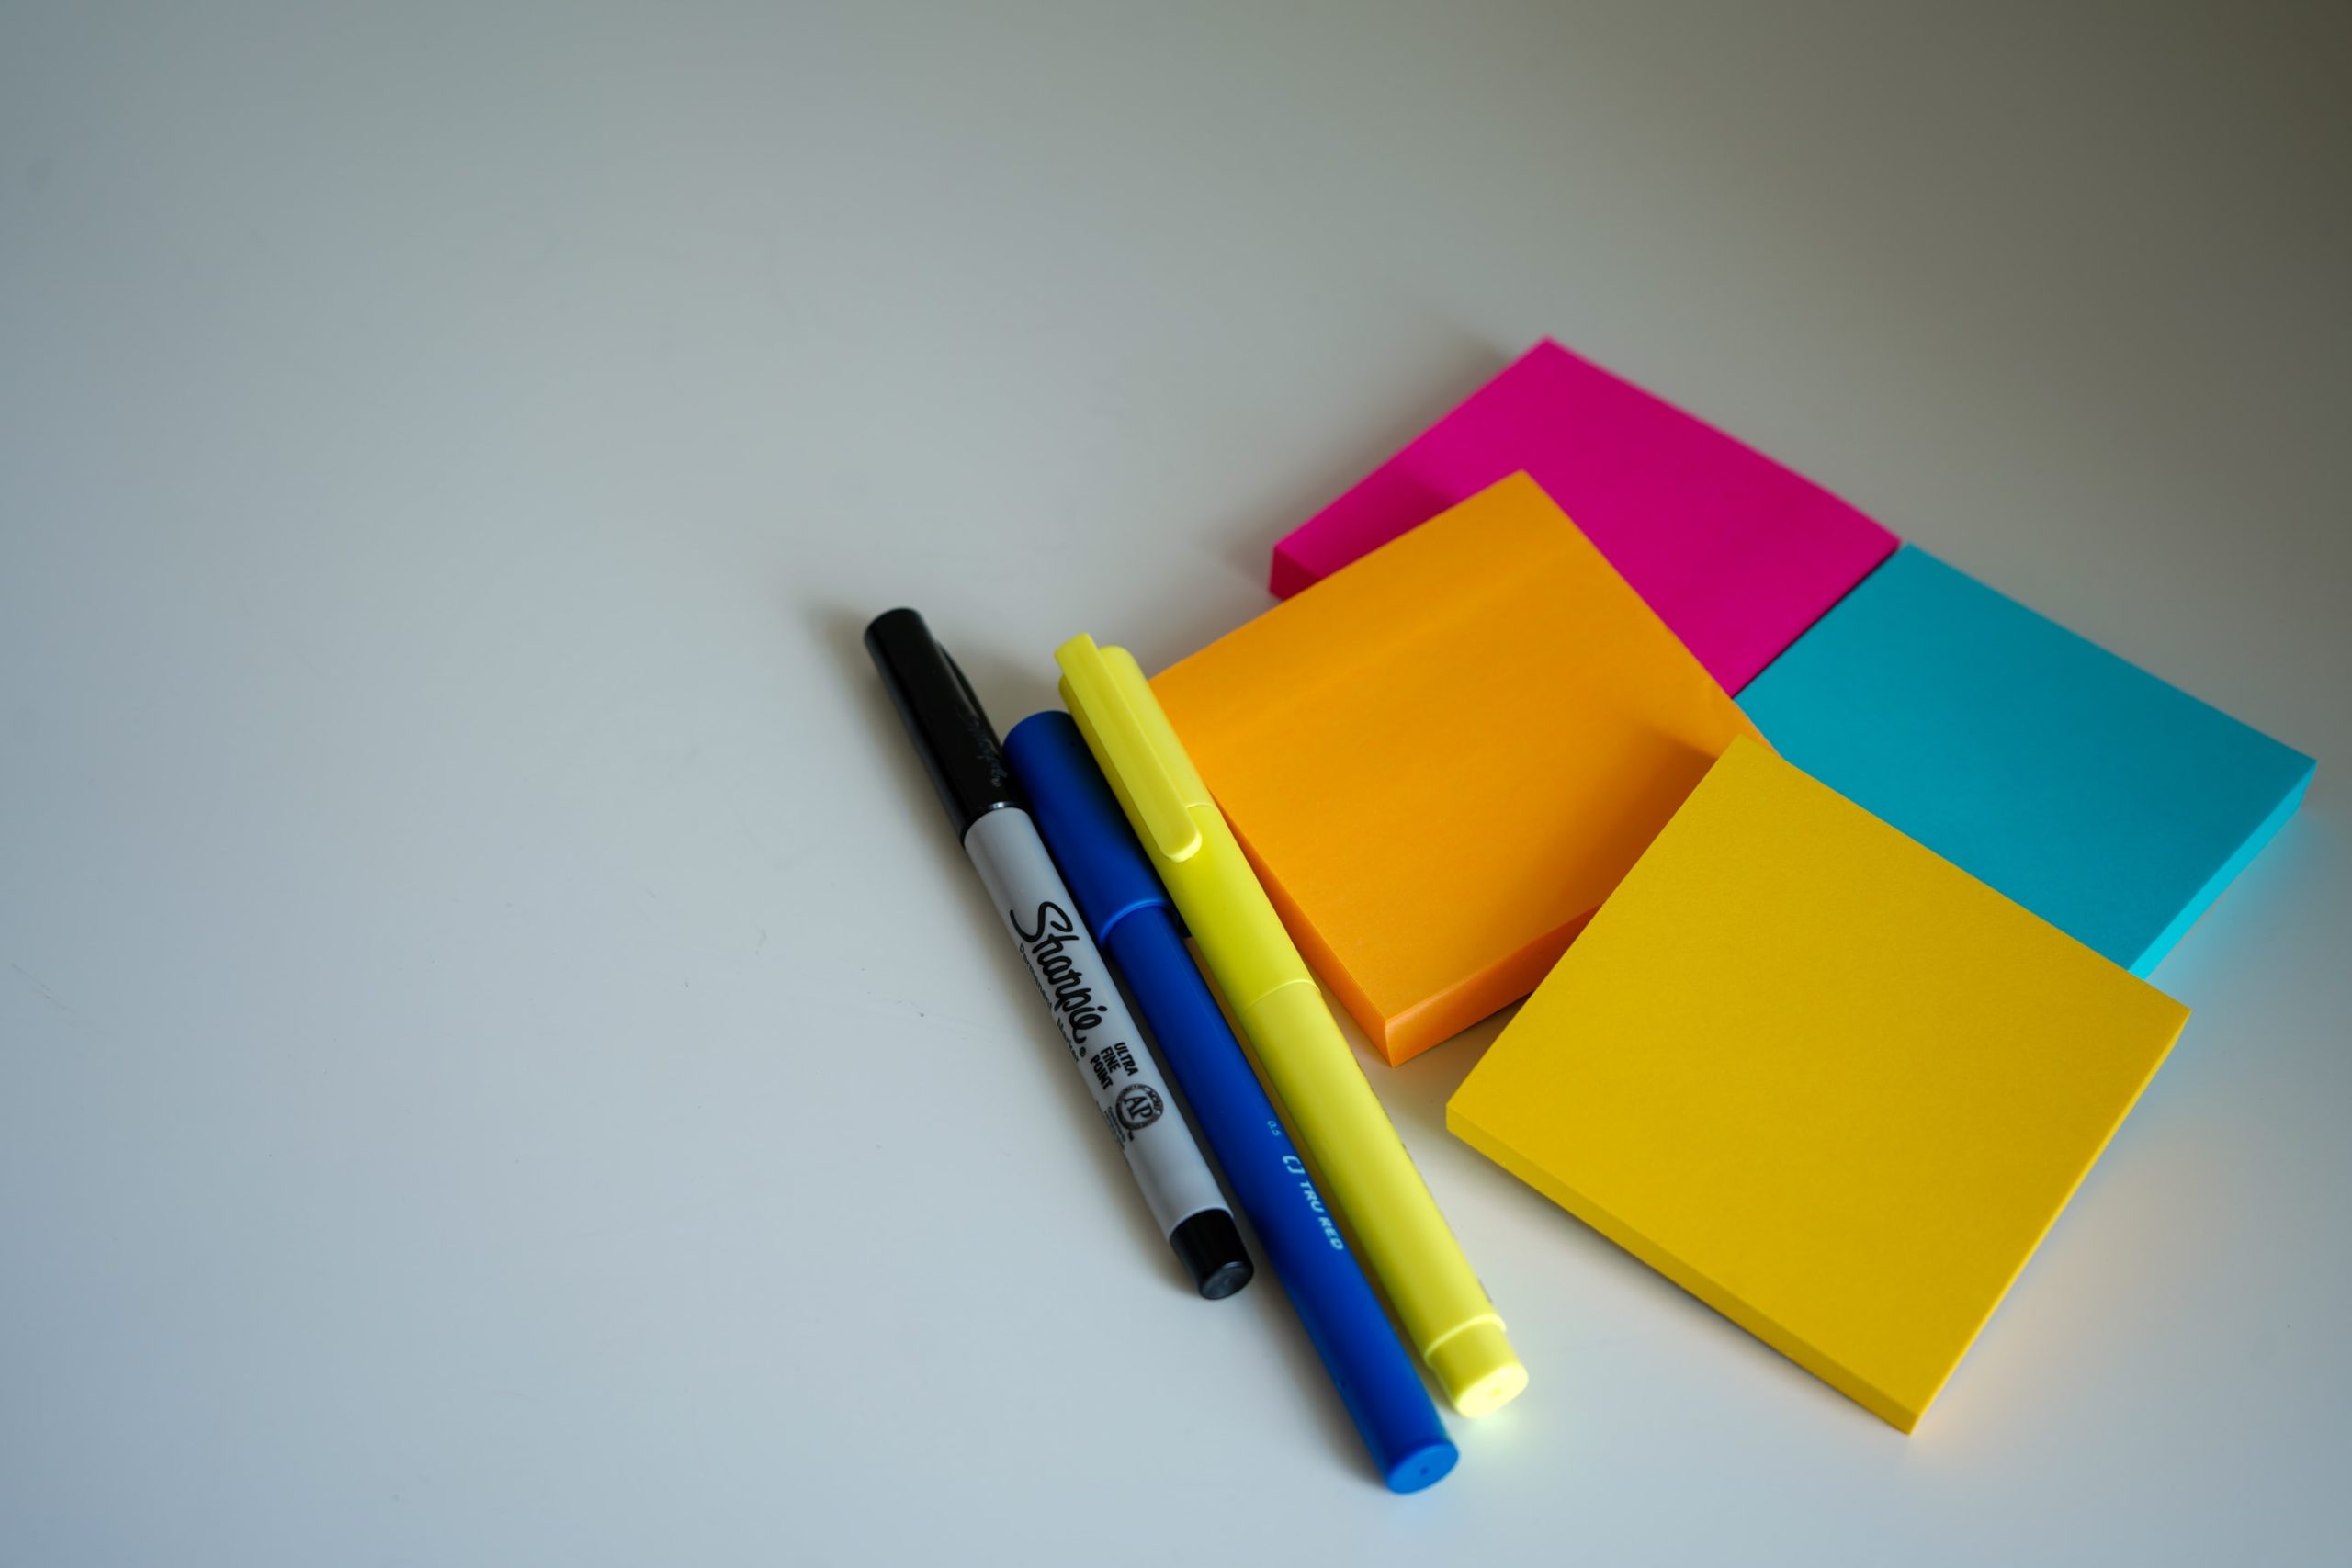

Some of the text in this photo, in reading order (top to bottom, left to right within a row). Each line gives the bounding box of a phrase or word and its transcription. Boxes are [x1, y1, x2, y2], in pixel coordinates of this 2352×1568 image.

[1010, 901, 1108, 1044] Sharpie
[1090, 1054, 1114, 1090] POINT
[1101, 1046, 1121, 1073] FINE
[1114, 1042, 1138, 1077] ULTRA
[1123, 1096, 1153, 1120] AP
[1300, 1180, 1344, 1250] TRU RED
